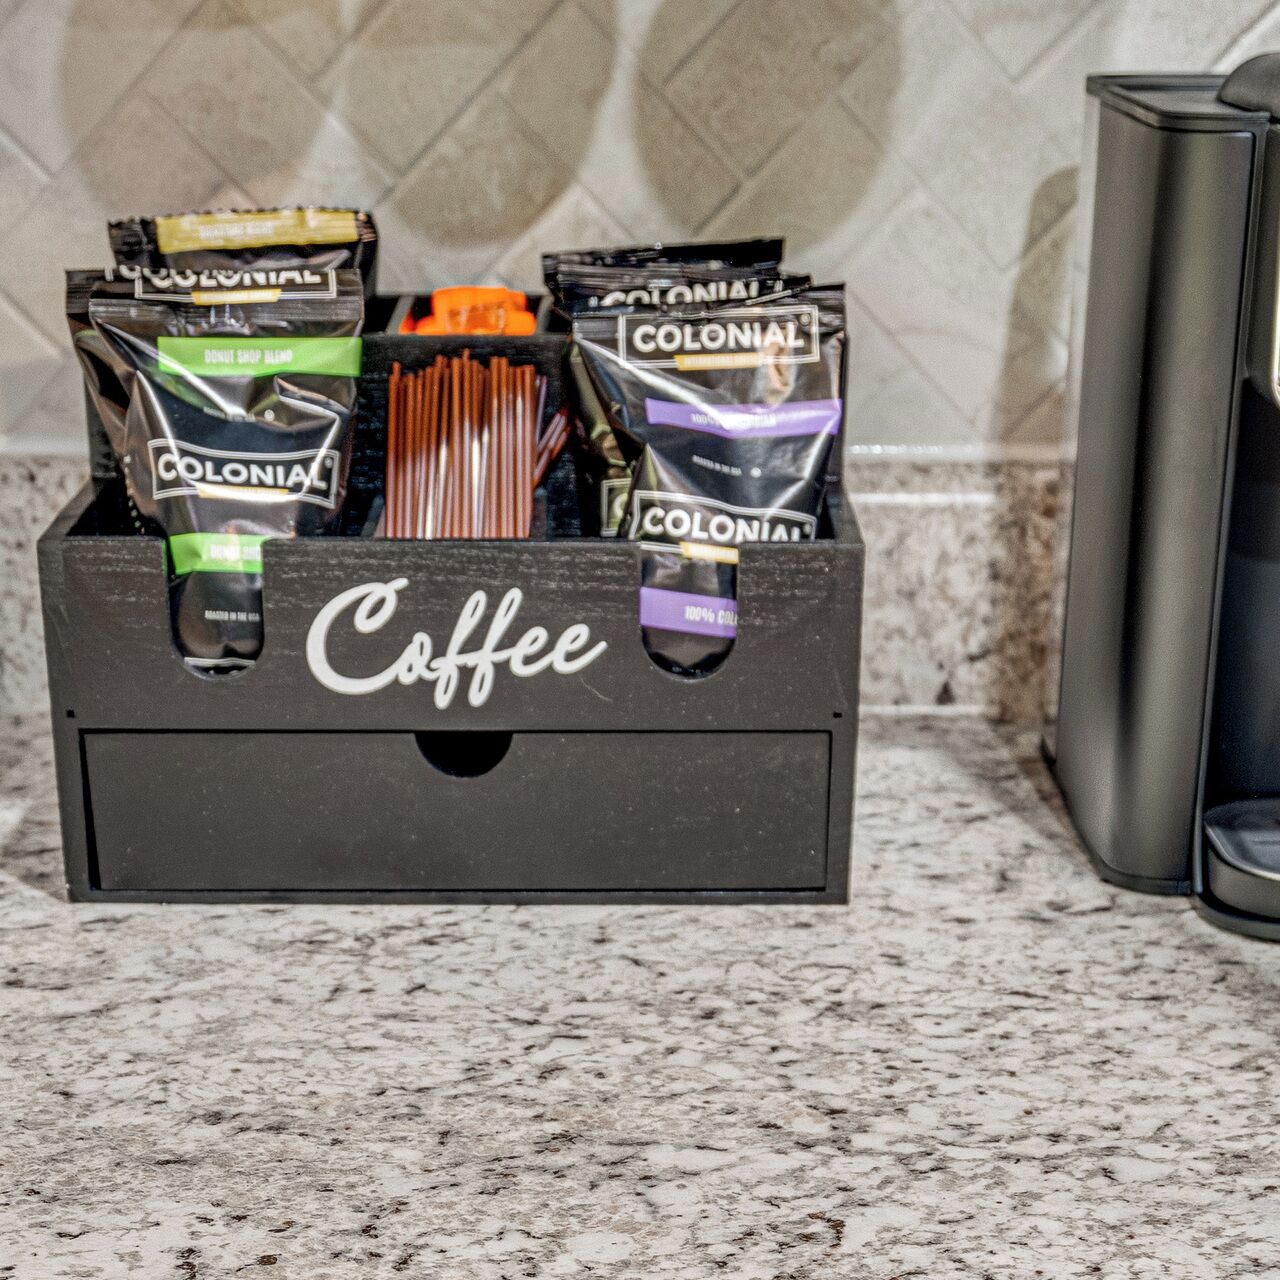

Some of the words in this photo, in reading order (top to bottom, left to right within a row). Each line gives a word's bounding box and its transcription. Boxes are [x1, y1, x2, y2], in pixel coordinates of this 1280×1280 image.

[633, 321, 805, 353] COLONIAL
[204, 349, 234, 366] DONUT
[237, 349, 262, 366] SHOP
[263, 349, 294, 366] BLEND
[158, 452, 328, 490] COLONIAL
[642, 506, 801, 543] COLONIAL
[685, 605, 715, 623] 100%
[306, 577, 608, 710] Coffee
